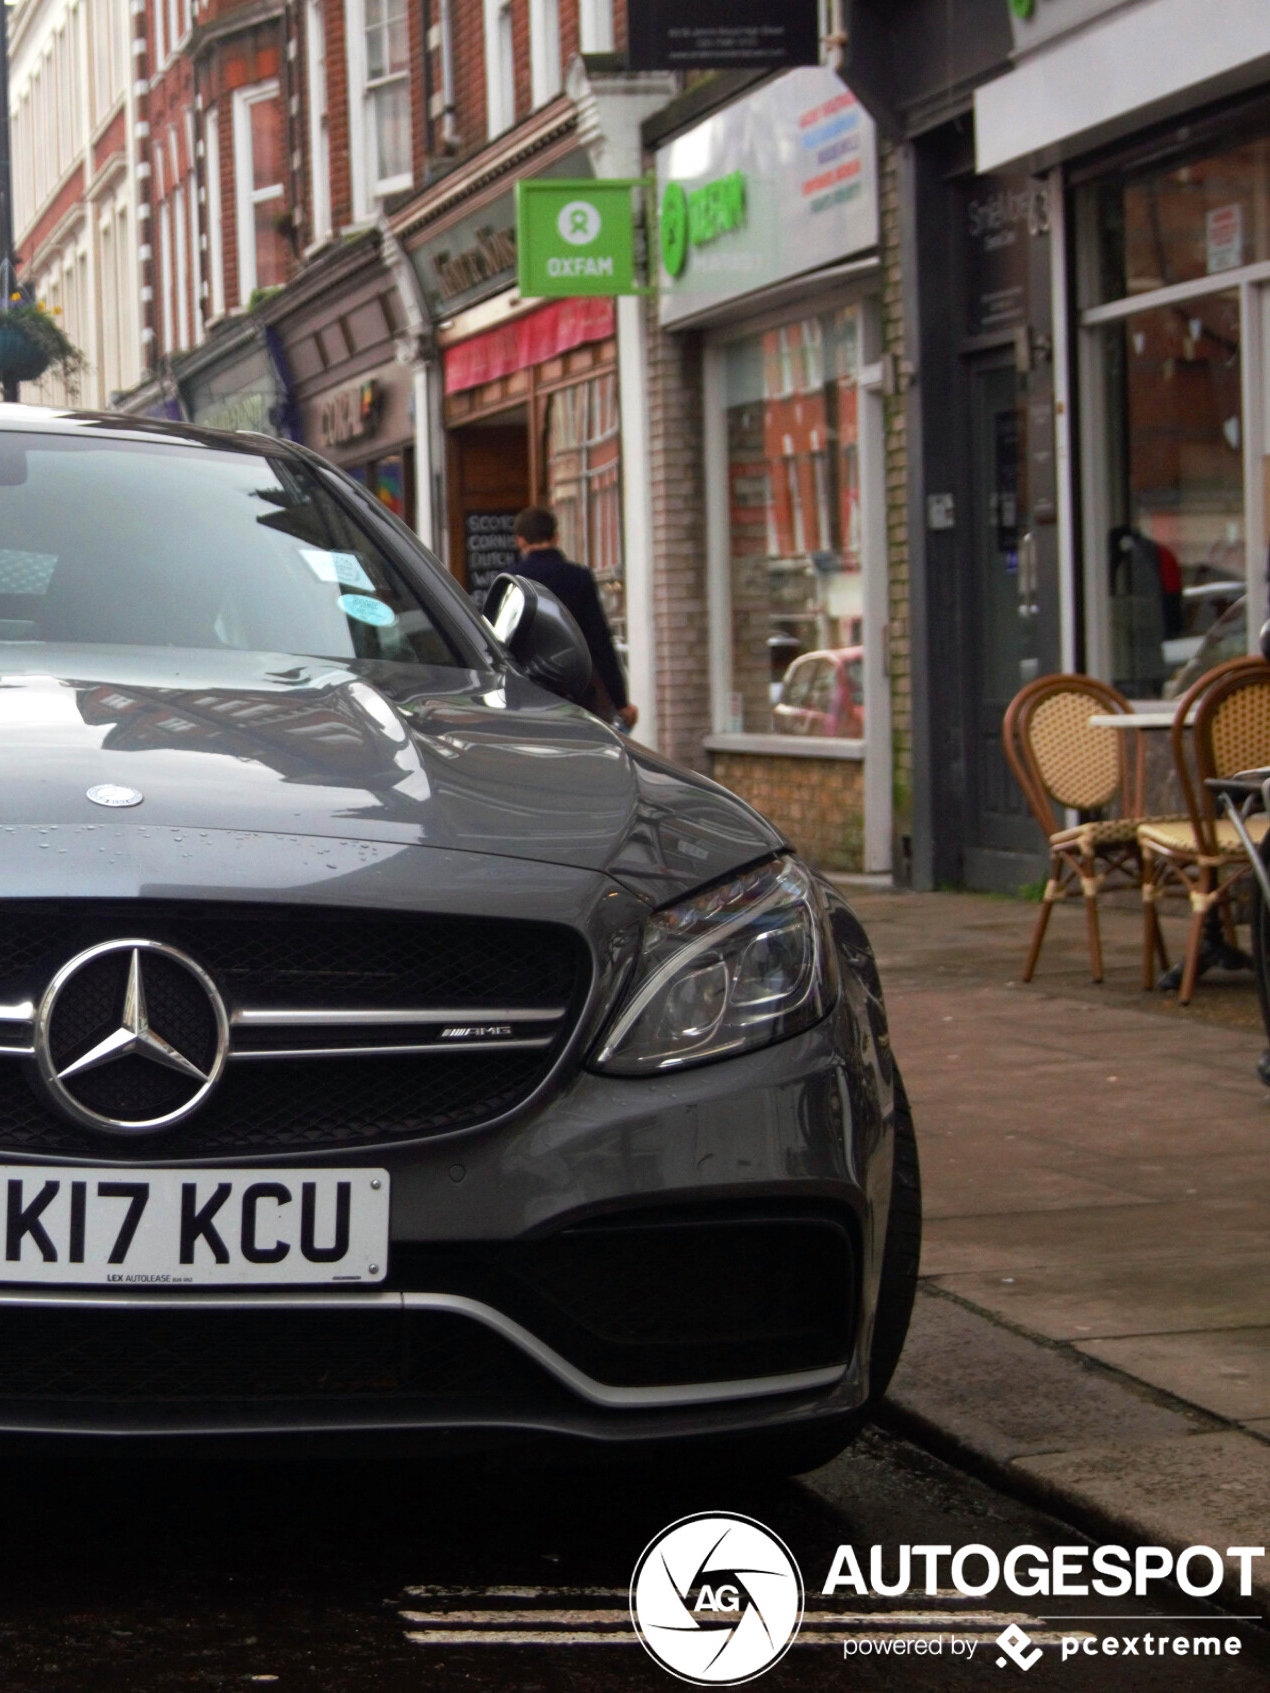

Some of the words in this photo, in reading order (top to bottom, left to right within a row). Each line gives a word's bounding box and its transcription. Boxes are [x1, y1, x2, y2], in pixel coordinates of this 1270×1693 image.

[547, 256, 614, 277] OXFAM
[179, 1181, 352, 1266] KCU
[106, 1274, 124, 1283] LEX
[125, 1274, 171, 1283] AUTOLEASE
